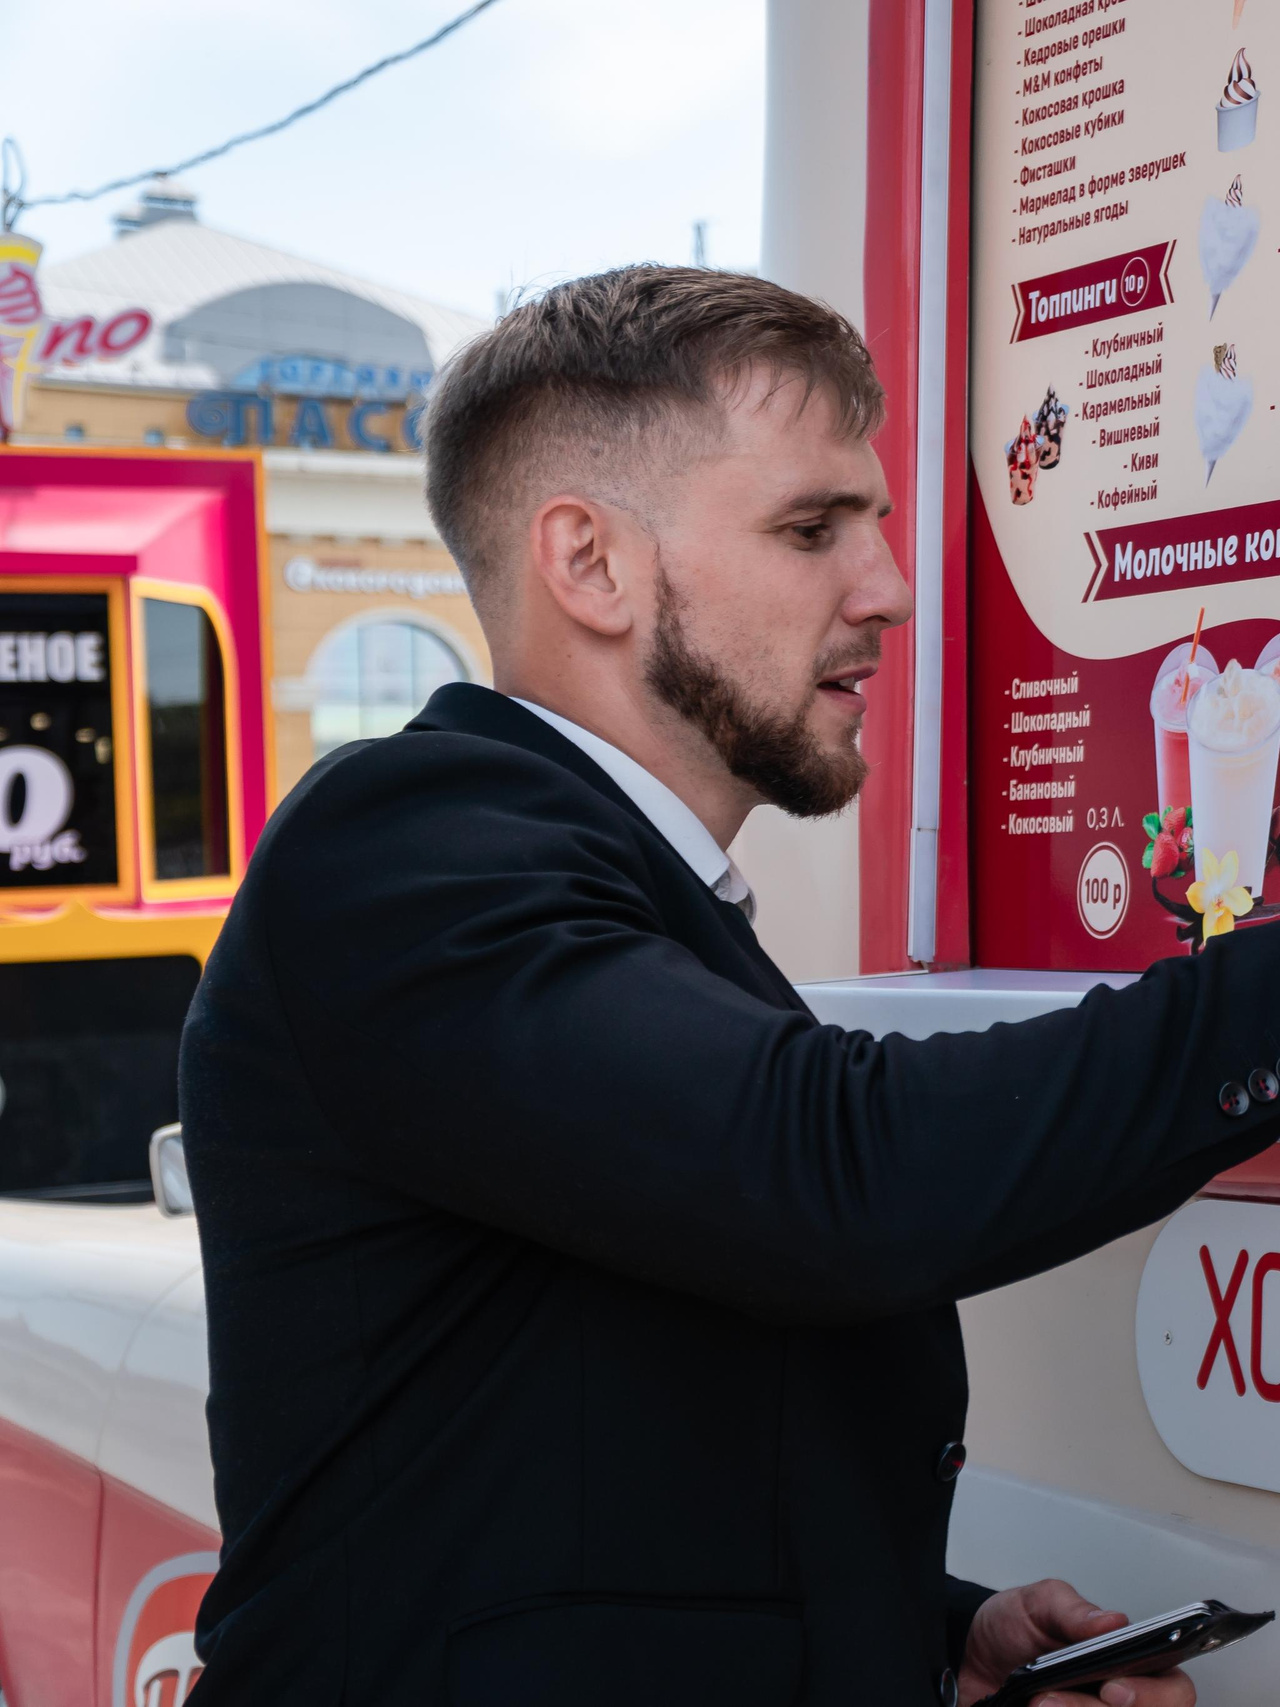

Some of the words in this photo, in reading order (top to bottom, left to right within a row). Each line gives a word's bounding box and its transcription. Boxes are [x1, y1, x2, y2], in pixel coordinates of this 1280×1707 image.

[1025, 0, 1094, 37] Шоколадная
[1024, 34, 1079, 67] Кедровые
[1081, 18, 1126, 48] орешки
[1053, 56, 1103, 87] конфеты
[1021, 92, 1079, 126] Кокосовая
[1081, 78, 1125, 108] крошка
[1020, 122, 1081, 156] Кокосовые
[1083, 109, 1125, 136] кубики
[1019, 184, 1076, 216] Мармелад
[1079, 183, 1085, 198] в
[1088, 172, 1125, 199] форме
[1128, 151, 1187, 183] зверушек
[1020, 155, 1076, 187] Фисташки
[1018, 209, 1091, 245] Натуральные
[1093, 200, 1129, 224] ягоды
[1028, 278, 1117, 324] Топпинги
[1124, 274, 1136, 293] 10
[1091, 322, 1164, 359] Клубничный
[1086, 354, 1162, 389] Шоколадный
[1081, 386, 1161, 422] Карамельный
[1099, 417, 1160, 448] Вишневый
[1131, 452, 1159, 472] Киви
[1097, 479, 1158, 511] Кофейный
[1114, 535, 1238, 582] Молочные
[1012, 671, 1079, 700] Сливочный
[1011, 705, 1090, 734] Шоколадный
[1010, 740, 1084, 771] Клубничный
[1009, 775, 1075, 801] Банановый
[1008, 811, 1074, 835] Кокосовый
[1086, 808, 1108, 831] 0,3
[1111, 807, 1124, 828] Л.
[1085, 877, 1109, 903] 100
